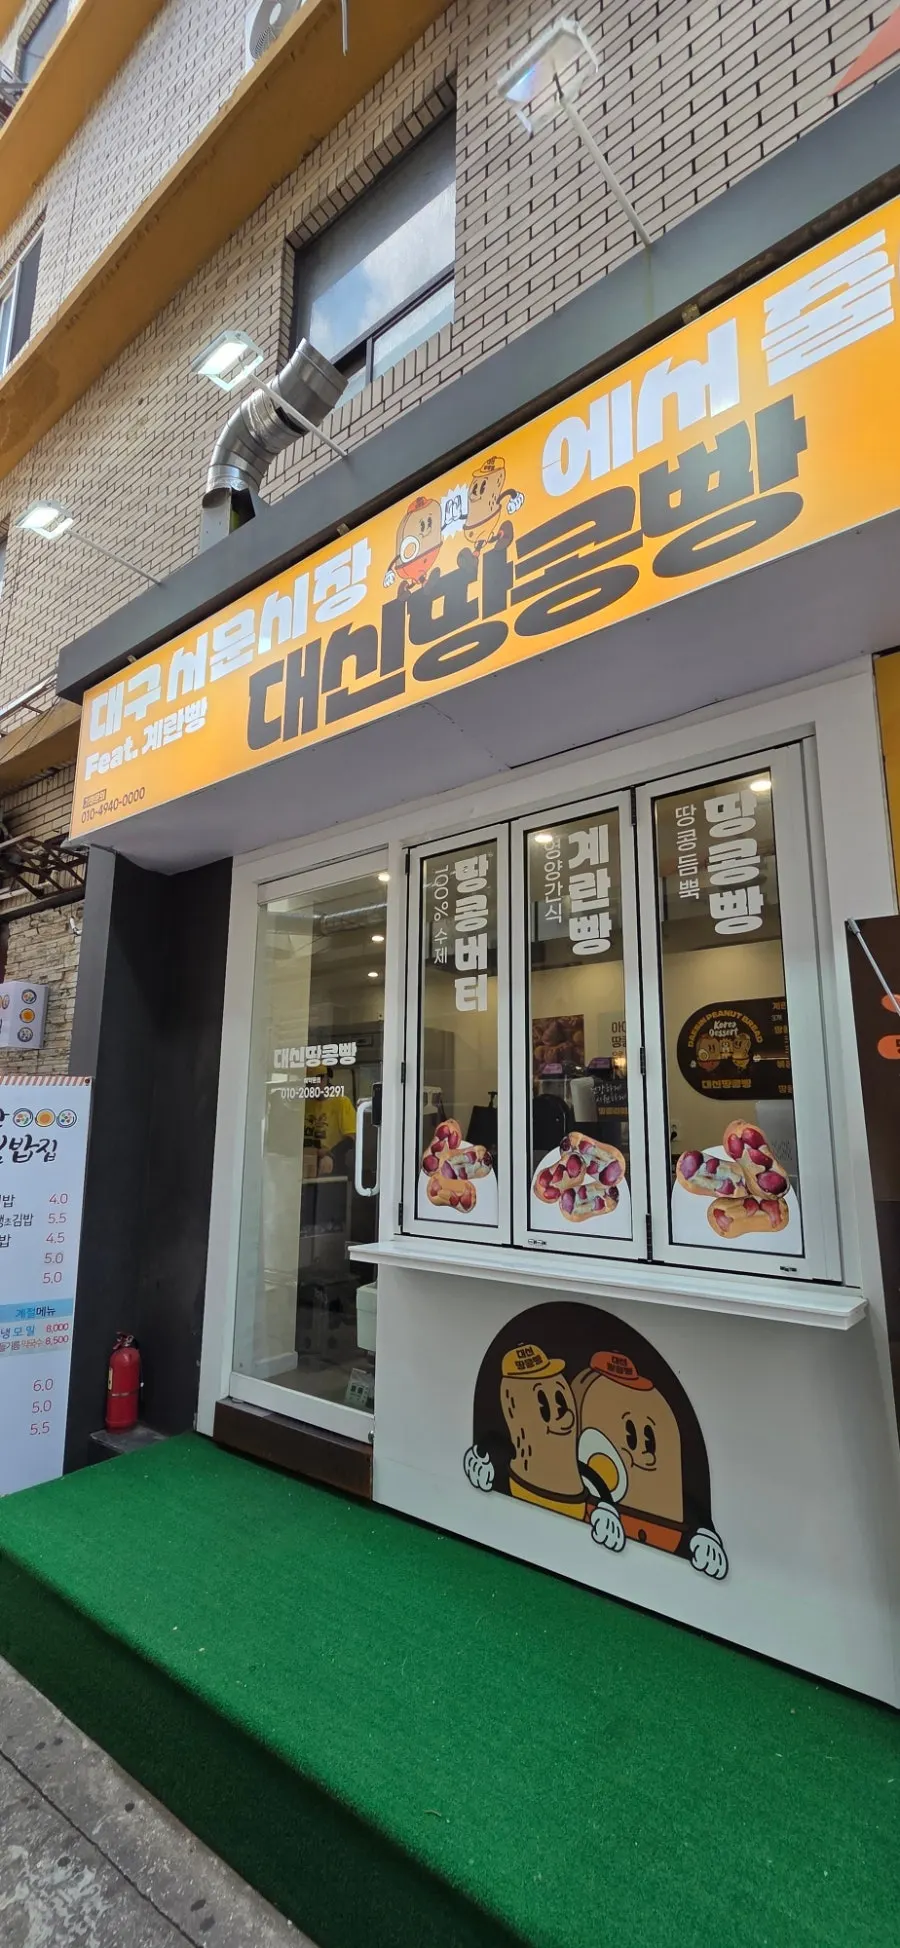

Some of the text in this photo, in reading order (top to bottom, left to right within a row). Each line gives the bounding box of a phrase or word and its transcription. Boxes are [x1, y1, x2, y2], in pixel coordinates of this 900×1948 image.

[541, 316, 741, 497] 에서
[247, 393, 808, 751] 대신땅콩빵
[84, 696, 208, 781] Feat. 계란빵
[81, 786, 146, 824] 010-4940-0000
[675, 803, 700, 900] 땅콩듬뿍
[703, 789, 765, 935] 땅콩빵
[543, 837, 564, 924] 영양간식
[568, 824, 613, 956] 계란빵
[433, 864, 449, 965] 100% 수제
[454, 852, 489, 1012] 땅콩버터
[706, 1009, 743, 1021] PEANUT
[708, 1027, 739, 1038] Dessert
[713, 1020, 737, 1030] Korea
[272, 1041, 358, 1069] 대신땅콩빵
[280, 1085, 345, 1100] 010-2080-3291
[49, 1193, 69, 1205] 4.0
[47, 1211, 68, 1224] 5.5
[45, 1231, 65, 1244] 4.5
[44, 1252, 64, 1265] 5.0
[42, 1271, 63, 1284] 5.0
[45, 1334, 70, 1346] 8,500
[33, 1378, 54, 1392] 6.0
[31, 1399, 52, 1414] 5.0
[29, 1421, 51, 1436] 5.5
